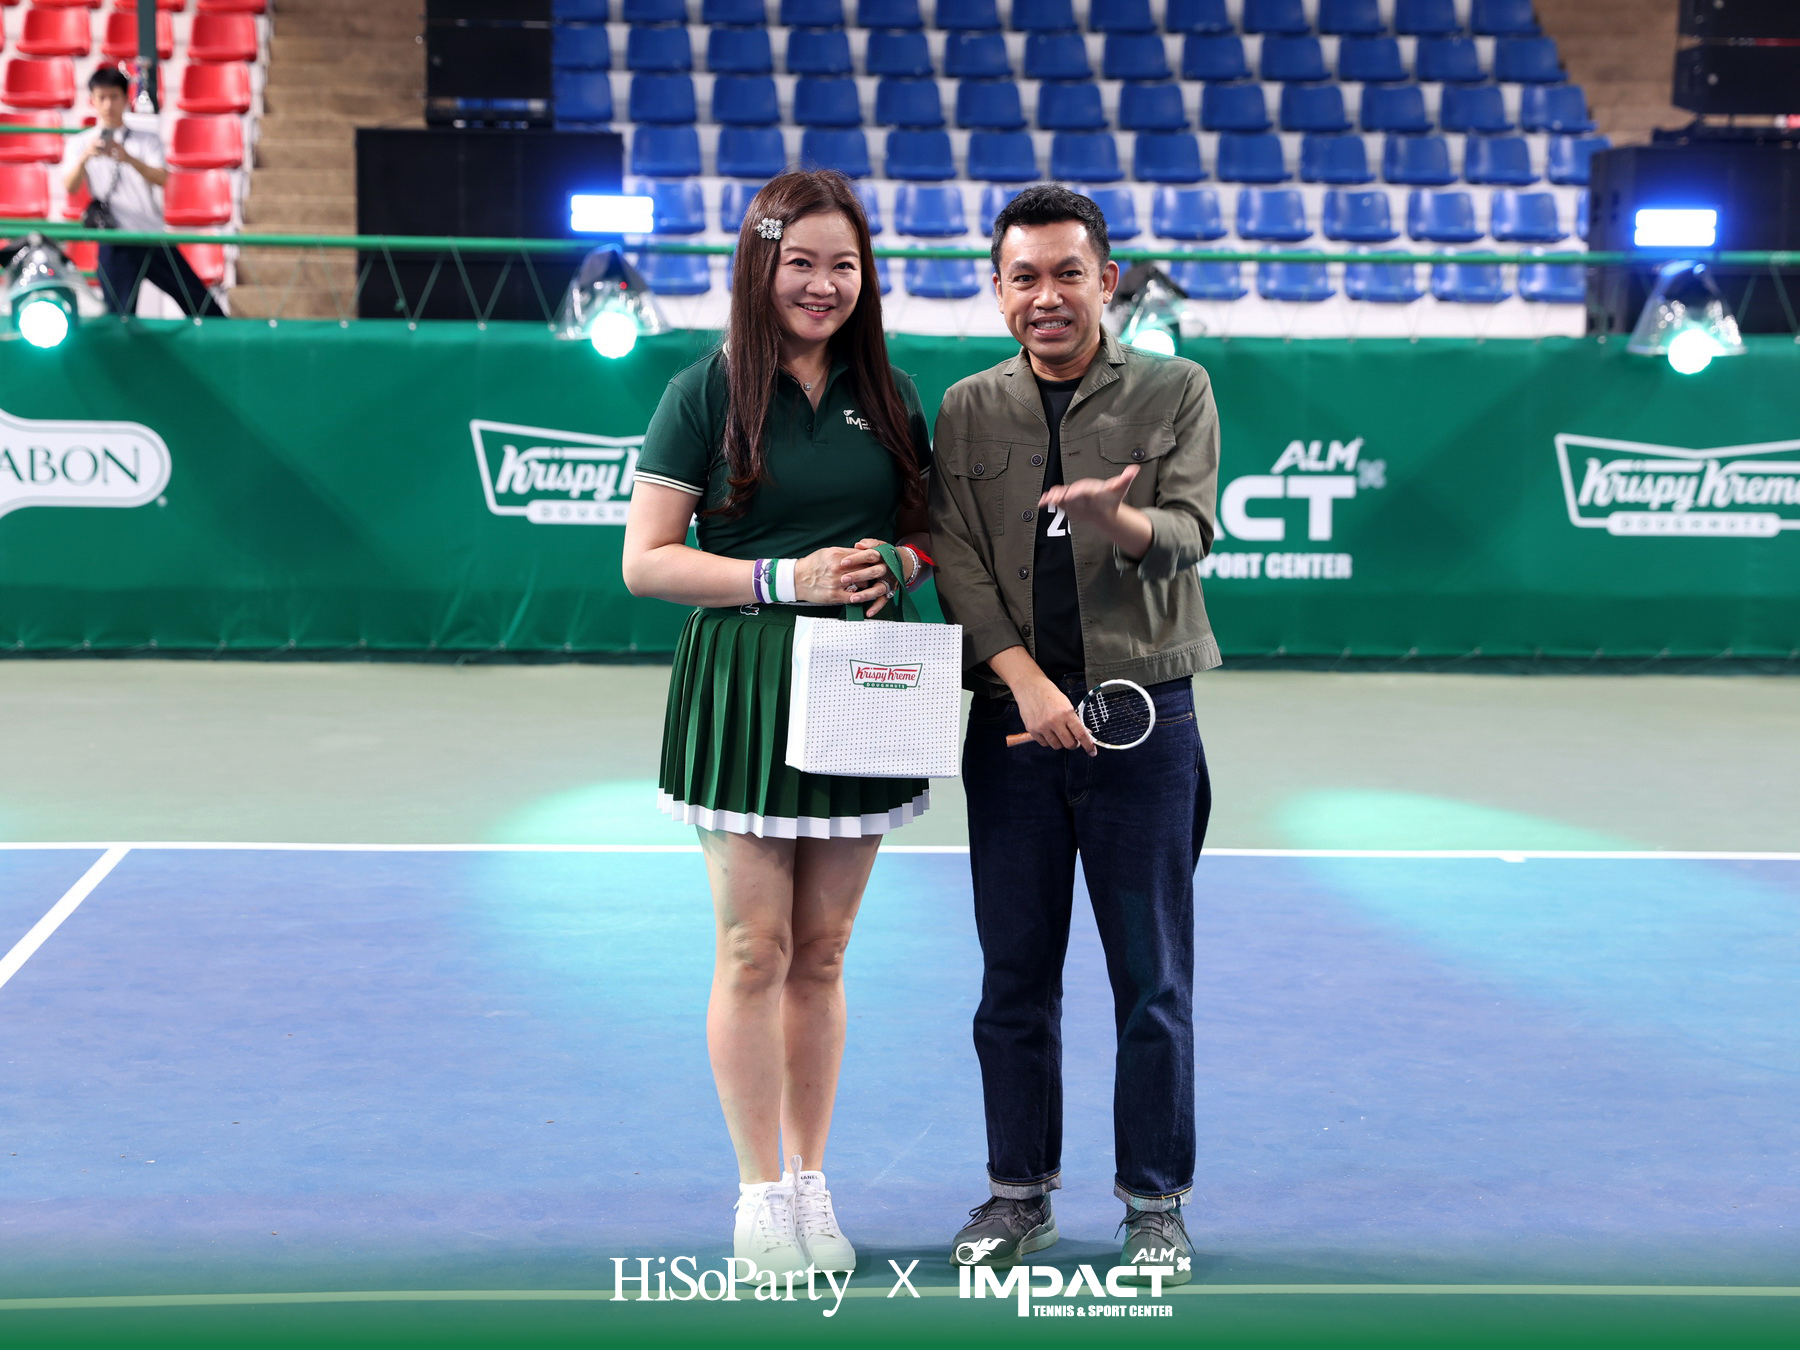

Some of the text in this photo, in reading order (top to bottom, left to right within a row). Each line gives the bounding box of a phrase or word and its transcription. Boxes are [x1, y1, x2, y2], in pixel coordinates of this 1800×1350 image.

[495, 445, 626, 500] Krispy
[1271, 437, 1364, 474] ALM
[1578, 457, 1703, 512] Krispy
[1213, 475, 1357, 541] CT
[1197, 553, 1353, 579] PORT CENTER
[855, 667, 918, 682] Krispy Kreme
